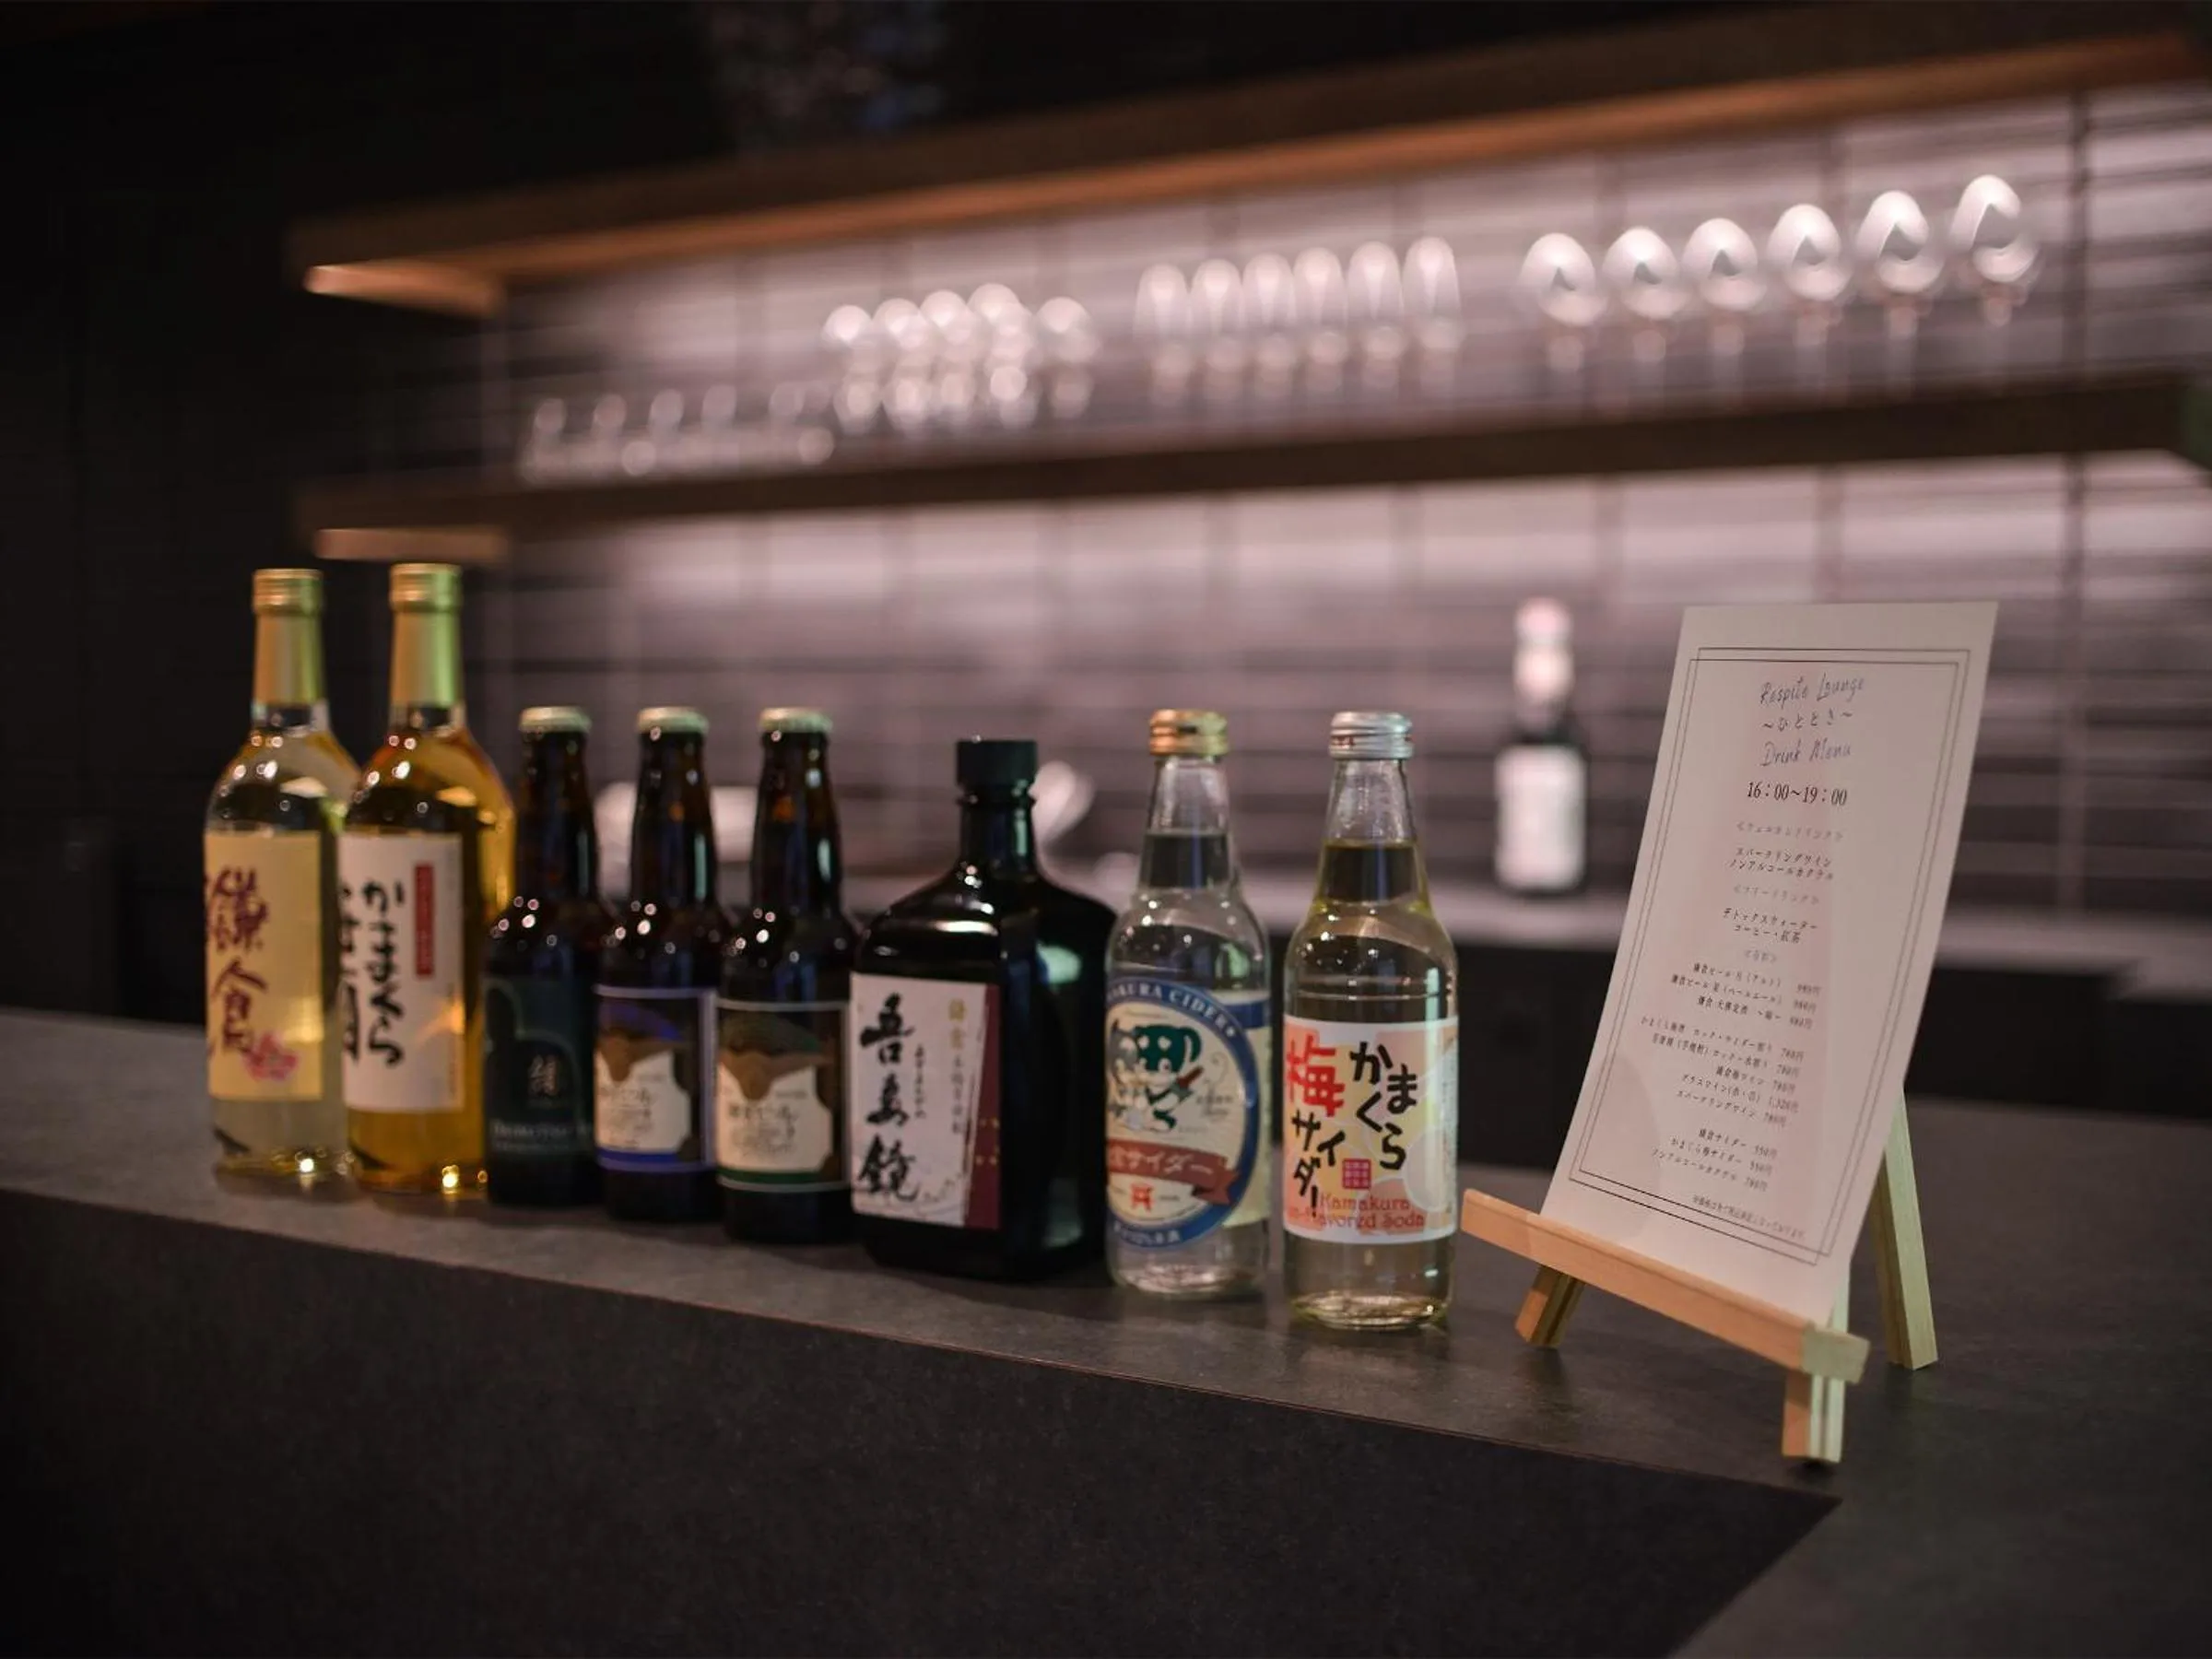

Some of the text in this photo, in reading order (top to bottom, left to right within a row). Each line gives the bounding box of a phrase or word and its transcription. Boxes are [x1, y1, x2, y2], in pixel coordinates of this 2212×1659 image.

[1760, 672, 1865, 709] Respite Lounge
[1759, 737, 1851, 766] Drink Menu
[361, 880, 406, 1067] かまくら
[1169, 989, 1229, 1030] CIDER
[1349, 1041, 1418, 1171] かまくら
[1319, 1192, 1411, 1212] Kamakura
